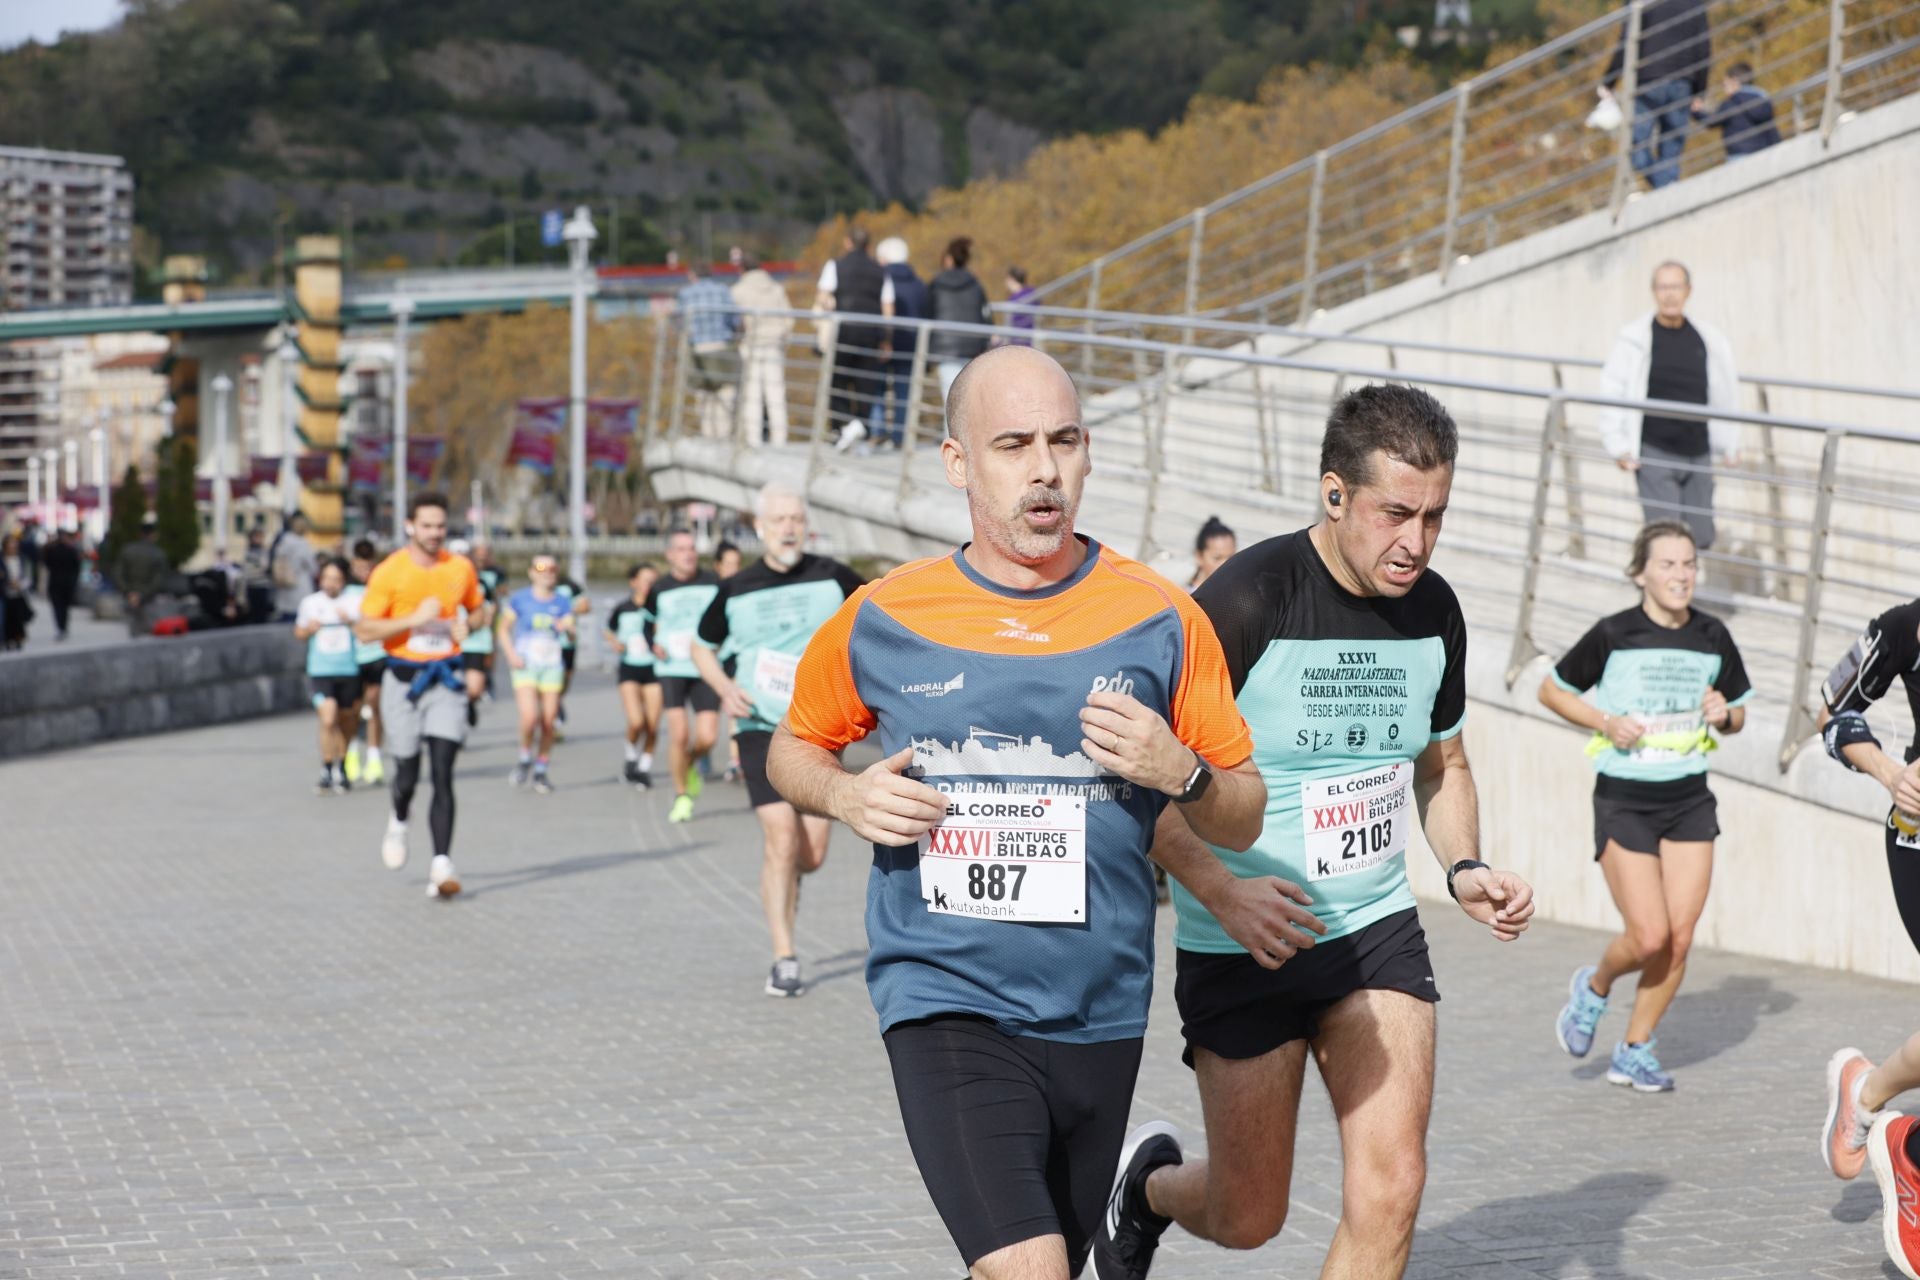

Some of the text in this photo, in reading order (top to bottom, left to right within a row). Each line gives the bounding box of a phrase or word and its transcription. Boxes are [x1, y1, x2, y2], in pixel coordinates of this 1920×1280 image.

[1338, 653, 1376, 664] XXXVI
[1301, 668, 1406, 681] NAZIOARTEKO LASTERKETA
[901, 682, 944, 693] LABORAL
[1300, 685, 1408, 698] CARRERA INTERNACIONAL
[1334, 703, 1370, 717] SANTURCE
[1372, 703, 1376, 716] A
[1380, 742, 1403, 751] Bilbao
[1328, 785, 1344, 795] EL
[1346, 771, 1396, 792] CORREO
[1369, 785, 1406, 808] SANTURCE
[945, 803, 1045, 818] EL CORREO
[1313, 801, 1365, 830] XXXVI
[1369, 796, 1405, 819] BILBAO
[928, 828, 991, 857] XXXVI
[998, 831, 1067, 844] SANTURCE
[1341, 819, 1392, 860] 2103
[997, 844, 1067, 858] BILBAO
[1332, 854, 1383, 874] kutxabank
[968, 863, 1027, 901] 887
[950, 899, 1016, 916] kutxabank
